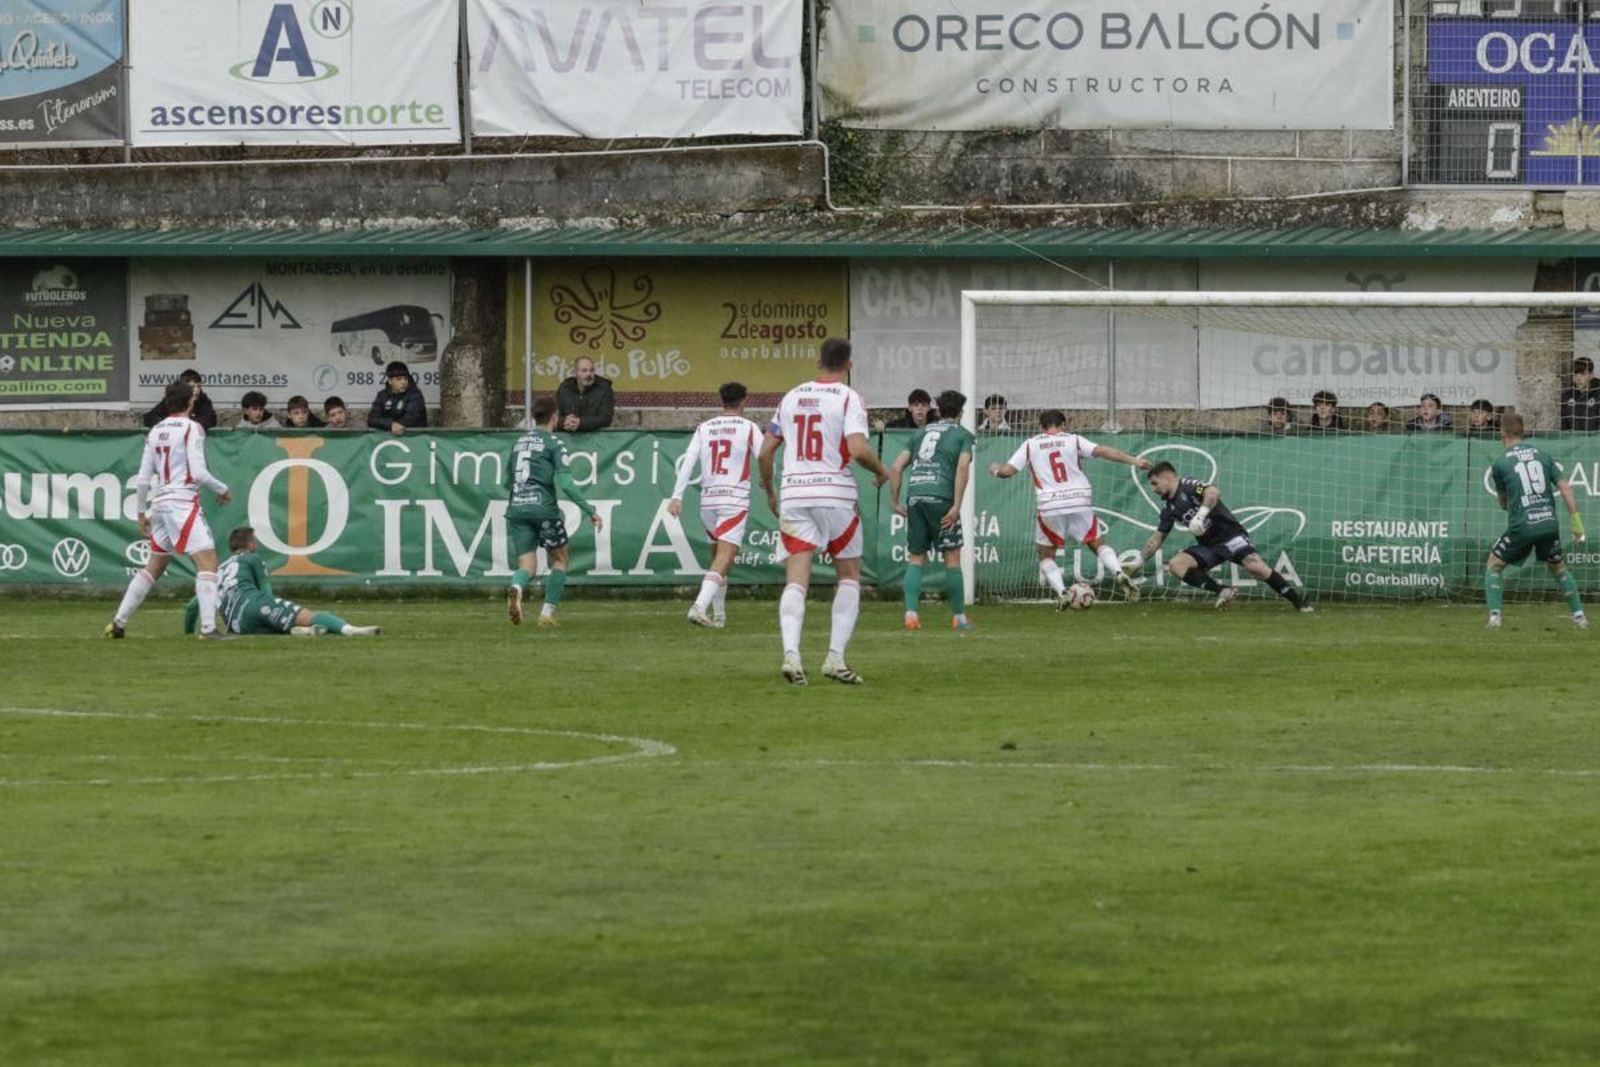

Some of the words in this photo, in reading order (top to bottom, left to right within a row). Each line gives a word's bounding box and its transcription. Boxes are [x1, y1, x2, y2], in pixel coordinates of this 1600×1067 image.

[80, 11, 115, 24] INOX
[322, 7, 342, 31] N
[893, 13, 1084, 52] ORECO
[1100, 3, 1321, 51] BALGÓN
[252, 3, 316, 77] A
[479, 4, 791, 73] AVATEL
[1476, 32, 1600, 74] OCA
[676, 77, 791, 99] TELECOM
[976, 77, 1233, 94] CONSTRUCTORA
[1448, 88, 1521, 108] ARENTEIRO
[149, 98, 445, 126] ascensoresnorte
[13, 313, 97, 329] Nueva
[751, 298, 828, 322] domingo
[0, 331, 113, 349] TIENDA
[720, 343, 817, 359] ocarballiñ
[878, 346, 959, 371] HOTEL
[138, 371, 289, 385] wwwontanesa.es
[346, 371, 374, 386] 988
[792, 413, 823, 462] 16
[918, 430, 941, 461] 6
[370, 439, 702, 487] Gimasio
[514, 450, 532, 484] 5
[708, 439, 732, 476] 12
[1048, 451, 1068, 484] 6
[1513, 460, 1546, 496] 19
[1331, 520, 1449, 539] RESTAURANTE
[1341, 541, 1442, 565] CAFETERÍA
[1345, 572, 1362, 587] (O
[1364, 571, 1446, 589] Carballiño)
